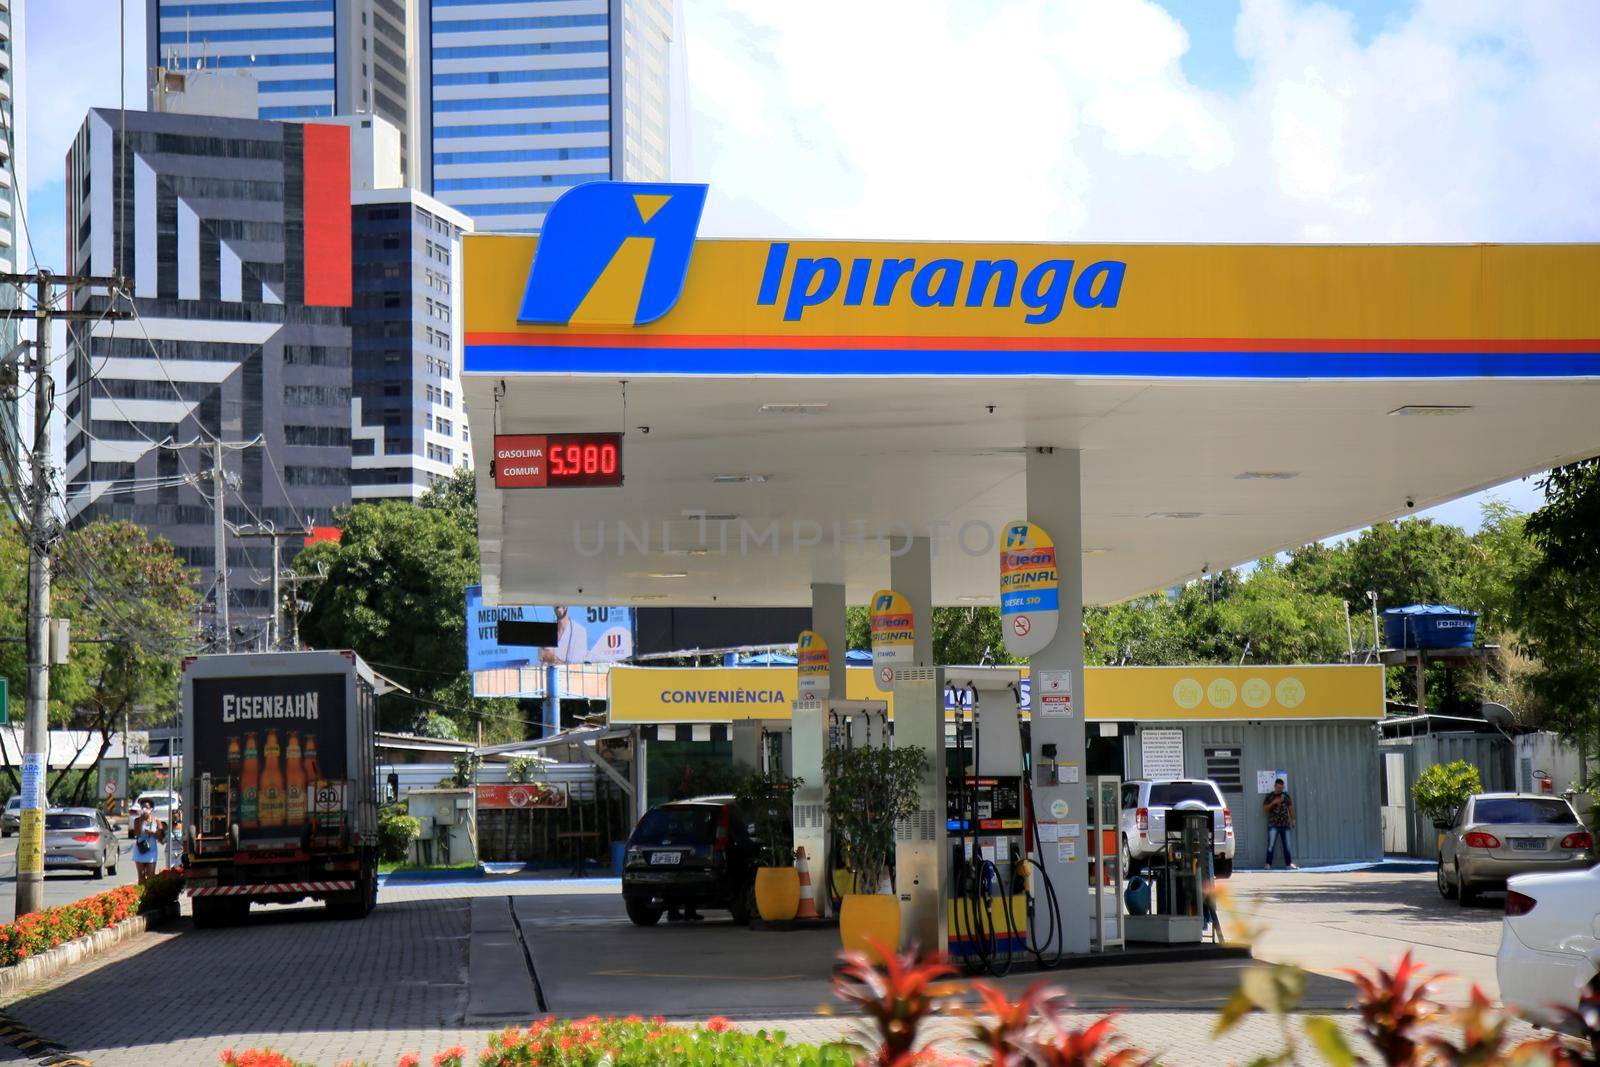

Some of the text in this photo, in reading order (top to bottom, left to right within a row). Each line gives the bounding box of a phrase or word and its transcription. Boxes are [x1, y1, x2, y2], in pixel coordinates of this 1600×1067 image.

[756, 243, 1127, 325] Ipiranga
[498, 449, 543, 459] GASOLINA
[503, 467, 539, 476] COMUM
[1004, 598, 1024, 607] DIESEL
[478, 607, 523, 623] MEDICINA
[661, 688, 785, 703] CONVENIÊNCIA
[318, 791, 336, 803] 80
